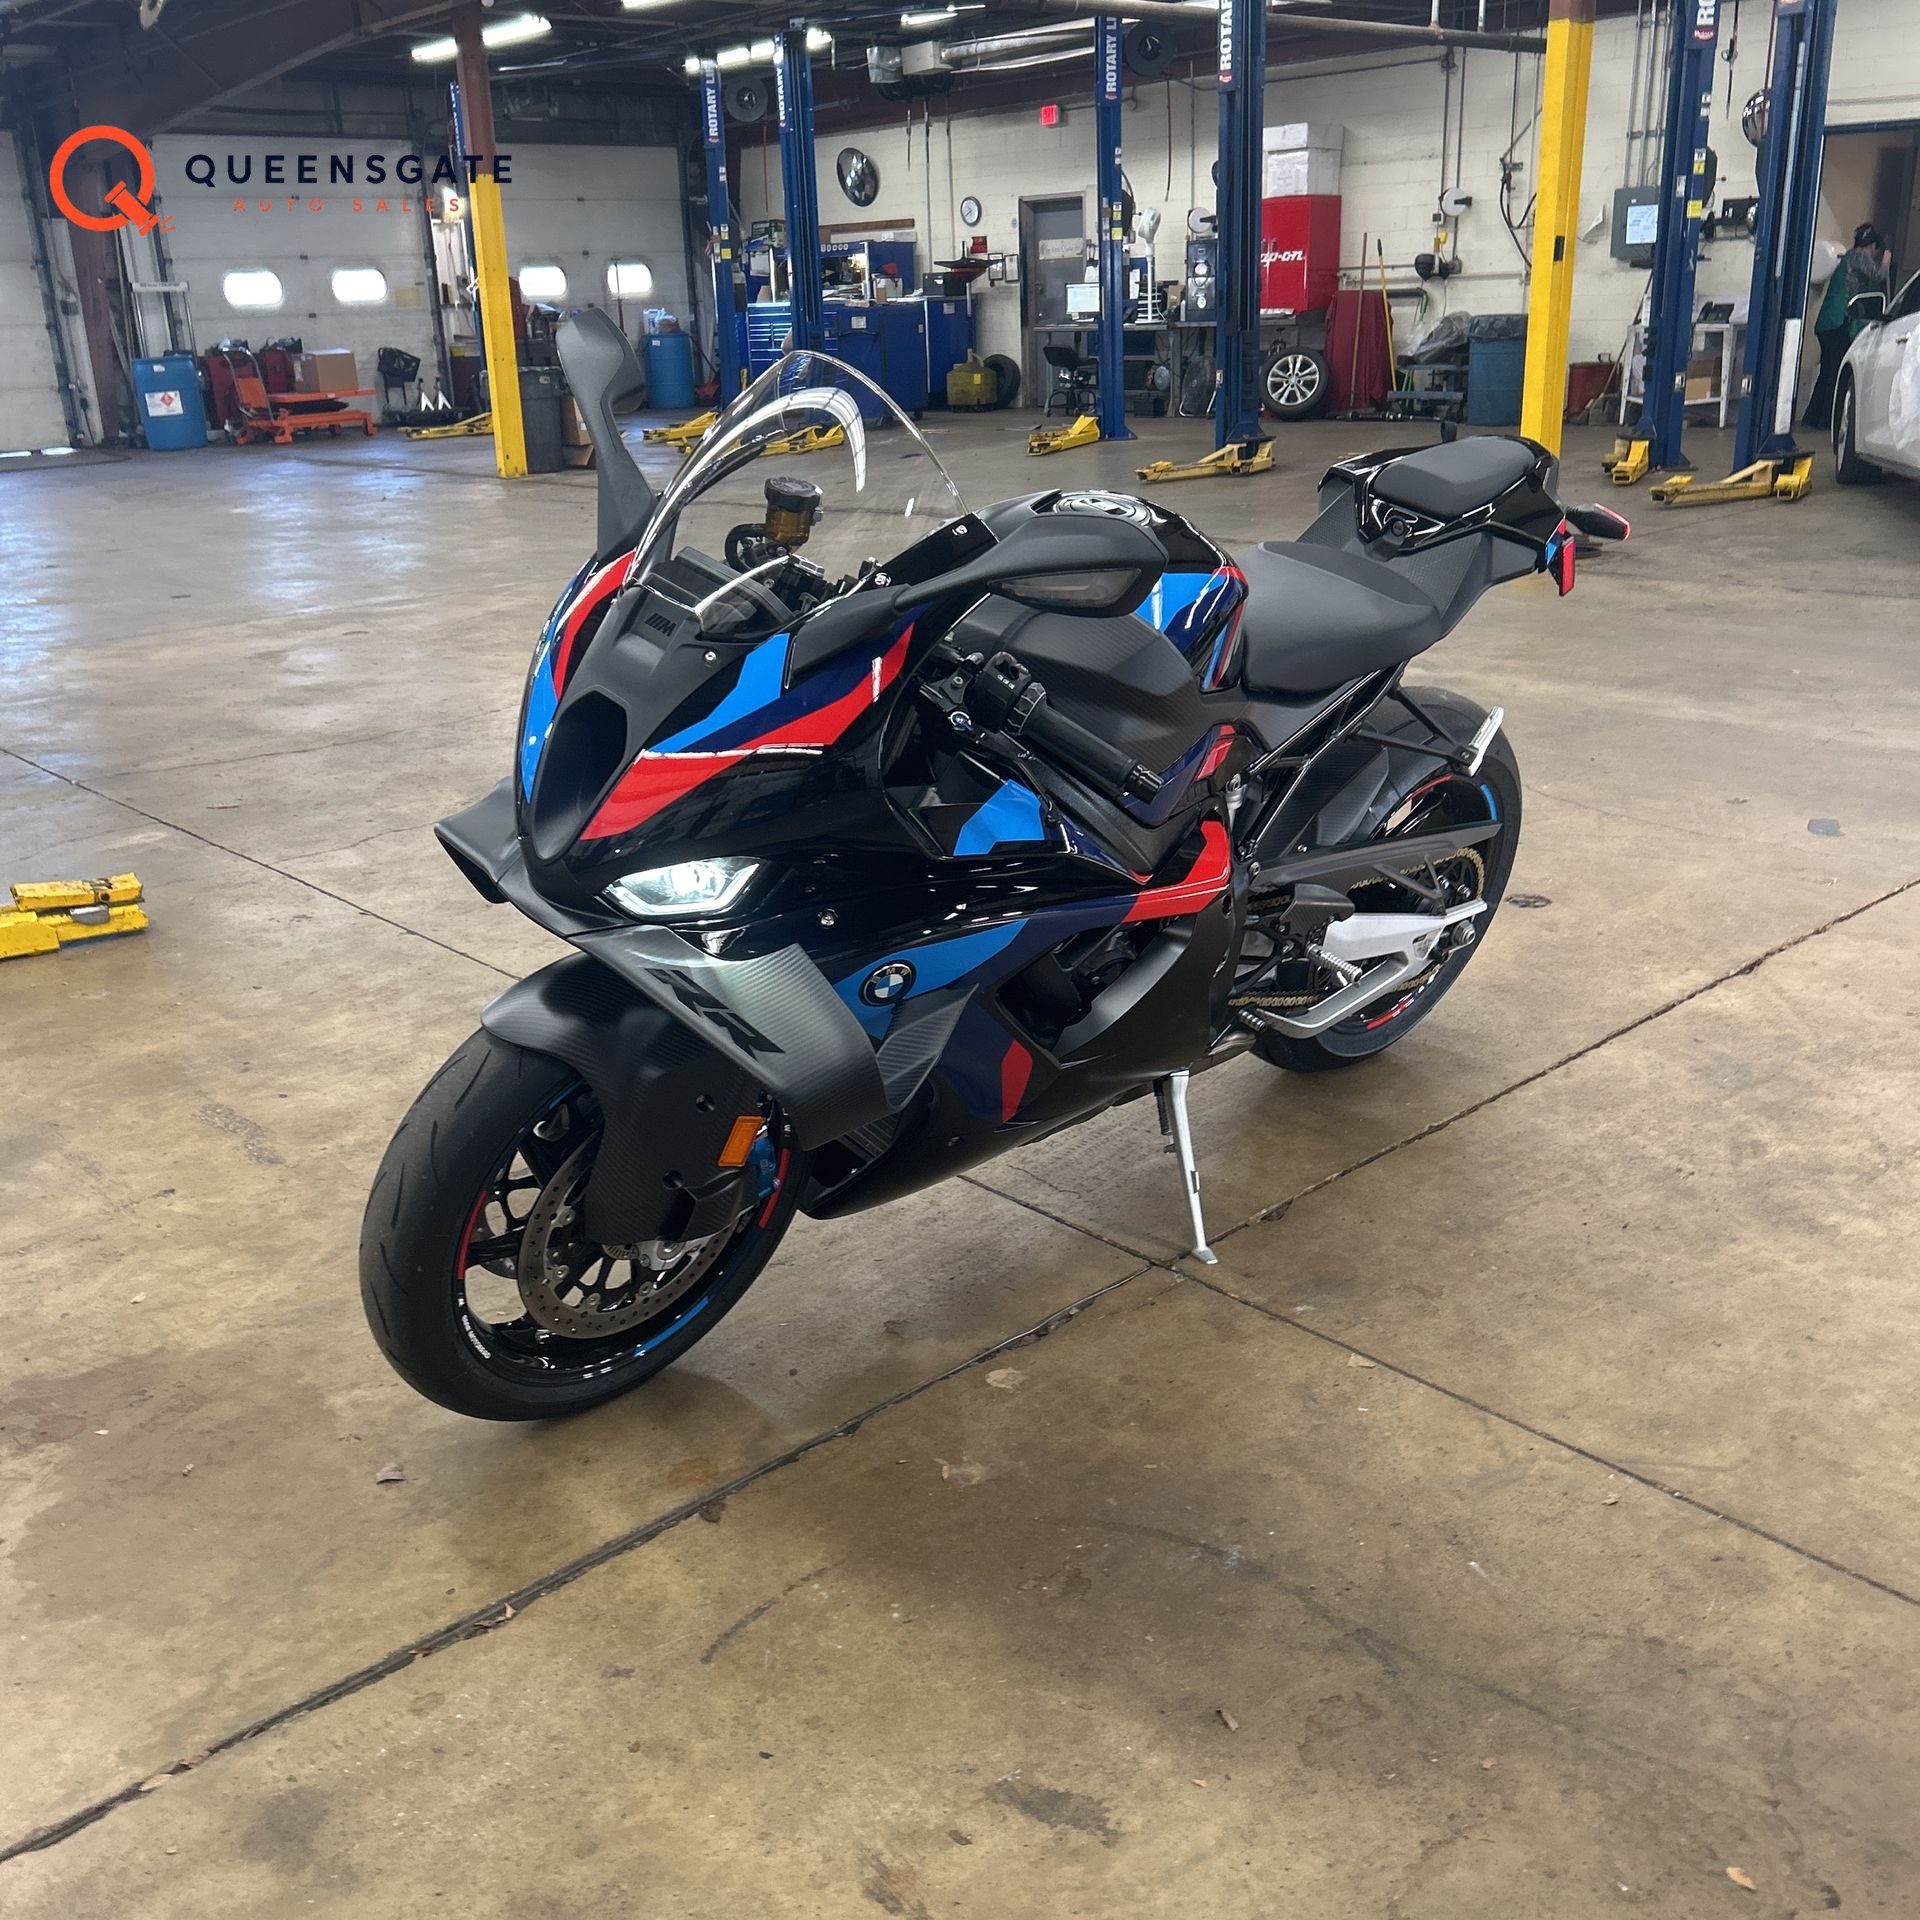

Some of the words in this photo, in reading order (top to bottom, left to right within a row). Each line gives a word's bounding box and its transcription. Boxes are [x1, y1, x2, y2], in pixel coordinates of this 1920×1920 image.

[1106, 34, 1117, 92] ROTARY
[706, 87, 718, 137] ROTARY
[776, 67, 786, 120] ROTARY
[870, 966, 910, 984] BMW
